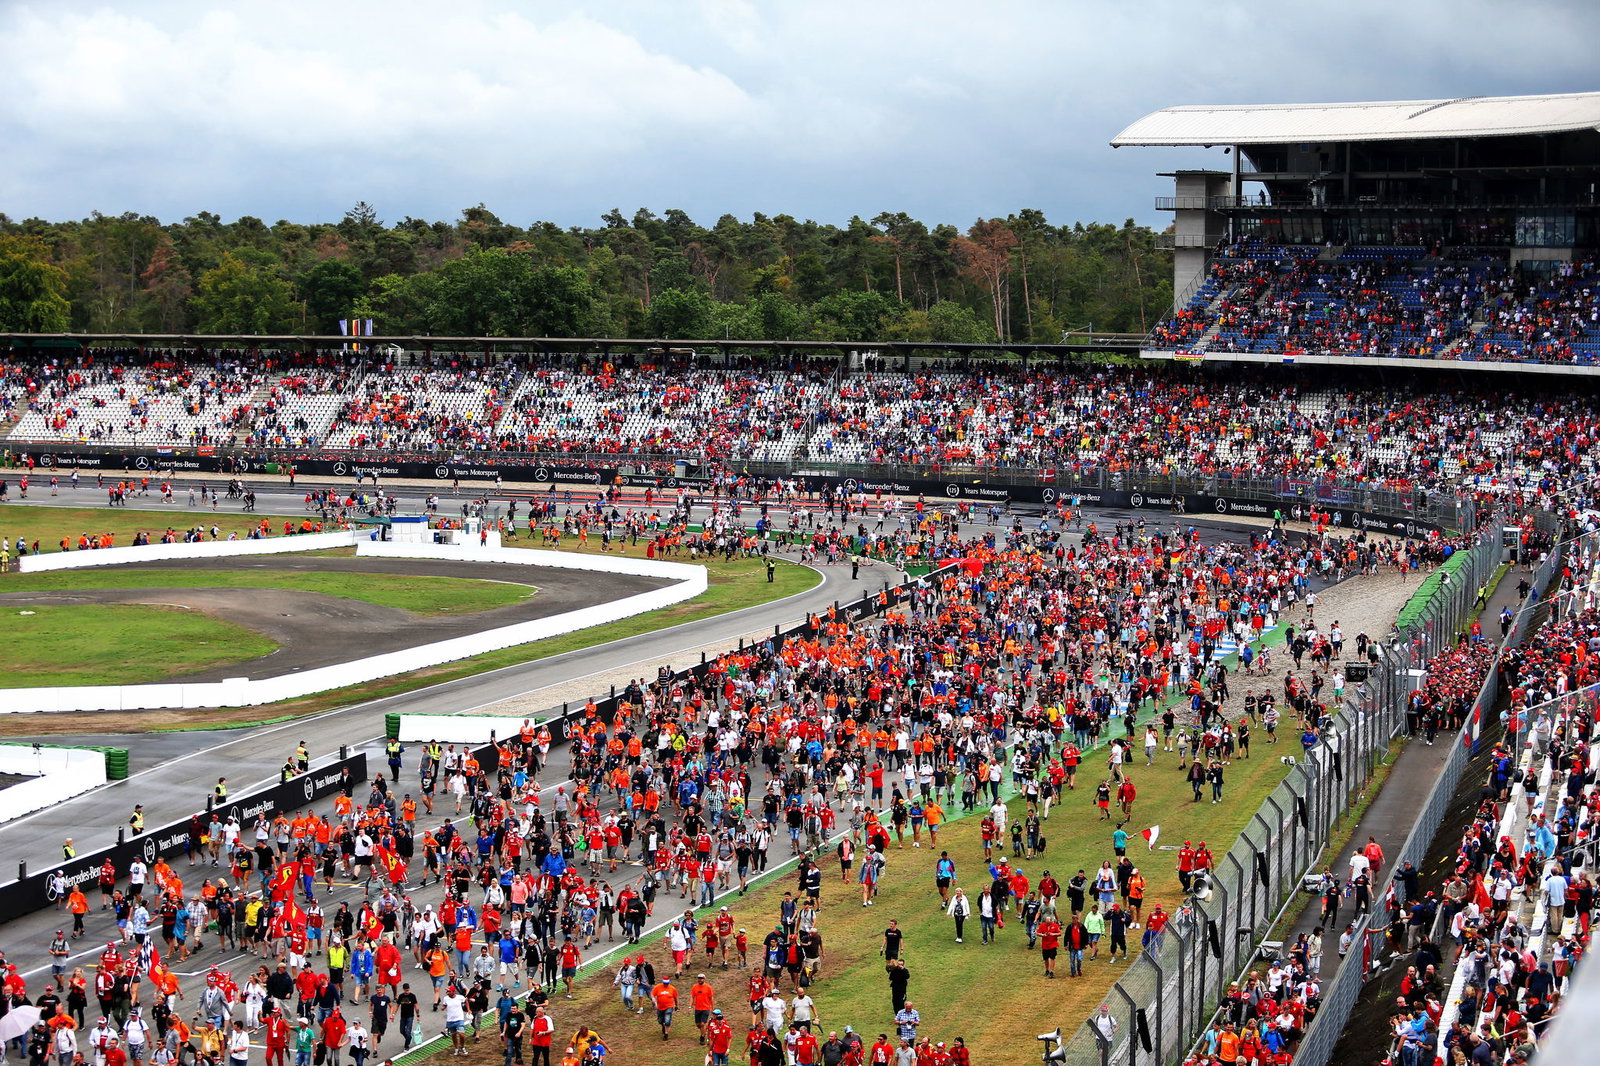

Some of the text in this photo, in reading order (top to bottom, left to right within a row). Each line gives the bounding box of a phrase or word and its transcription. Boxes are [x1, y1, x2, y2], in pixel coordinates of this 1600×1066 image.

[469, 469, 499, 477] Motorsport
[553, 471, 597, 480] Mercedes-Ben
[979, 488, 1008, 497] Motorsport
[1230, 502, 1267, 513] Mercedes-Benz
[315, 778, 325, 790] Years
[242, 800, 274, 820] Mercedes-Benz
[158, 839, 171, 851] Years
[64, 866, 101, 888] Mercedes-Ben
